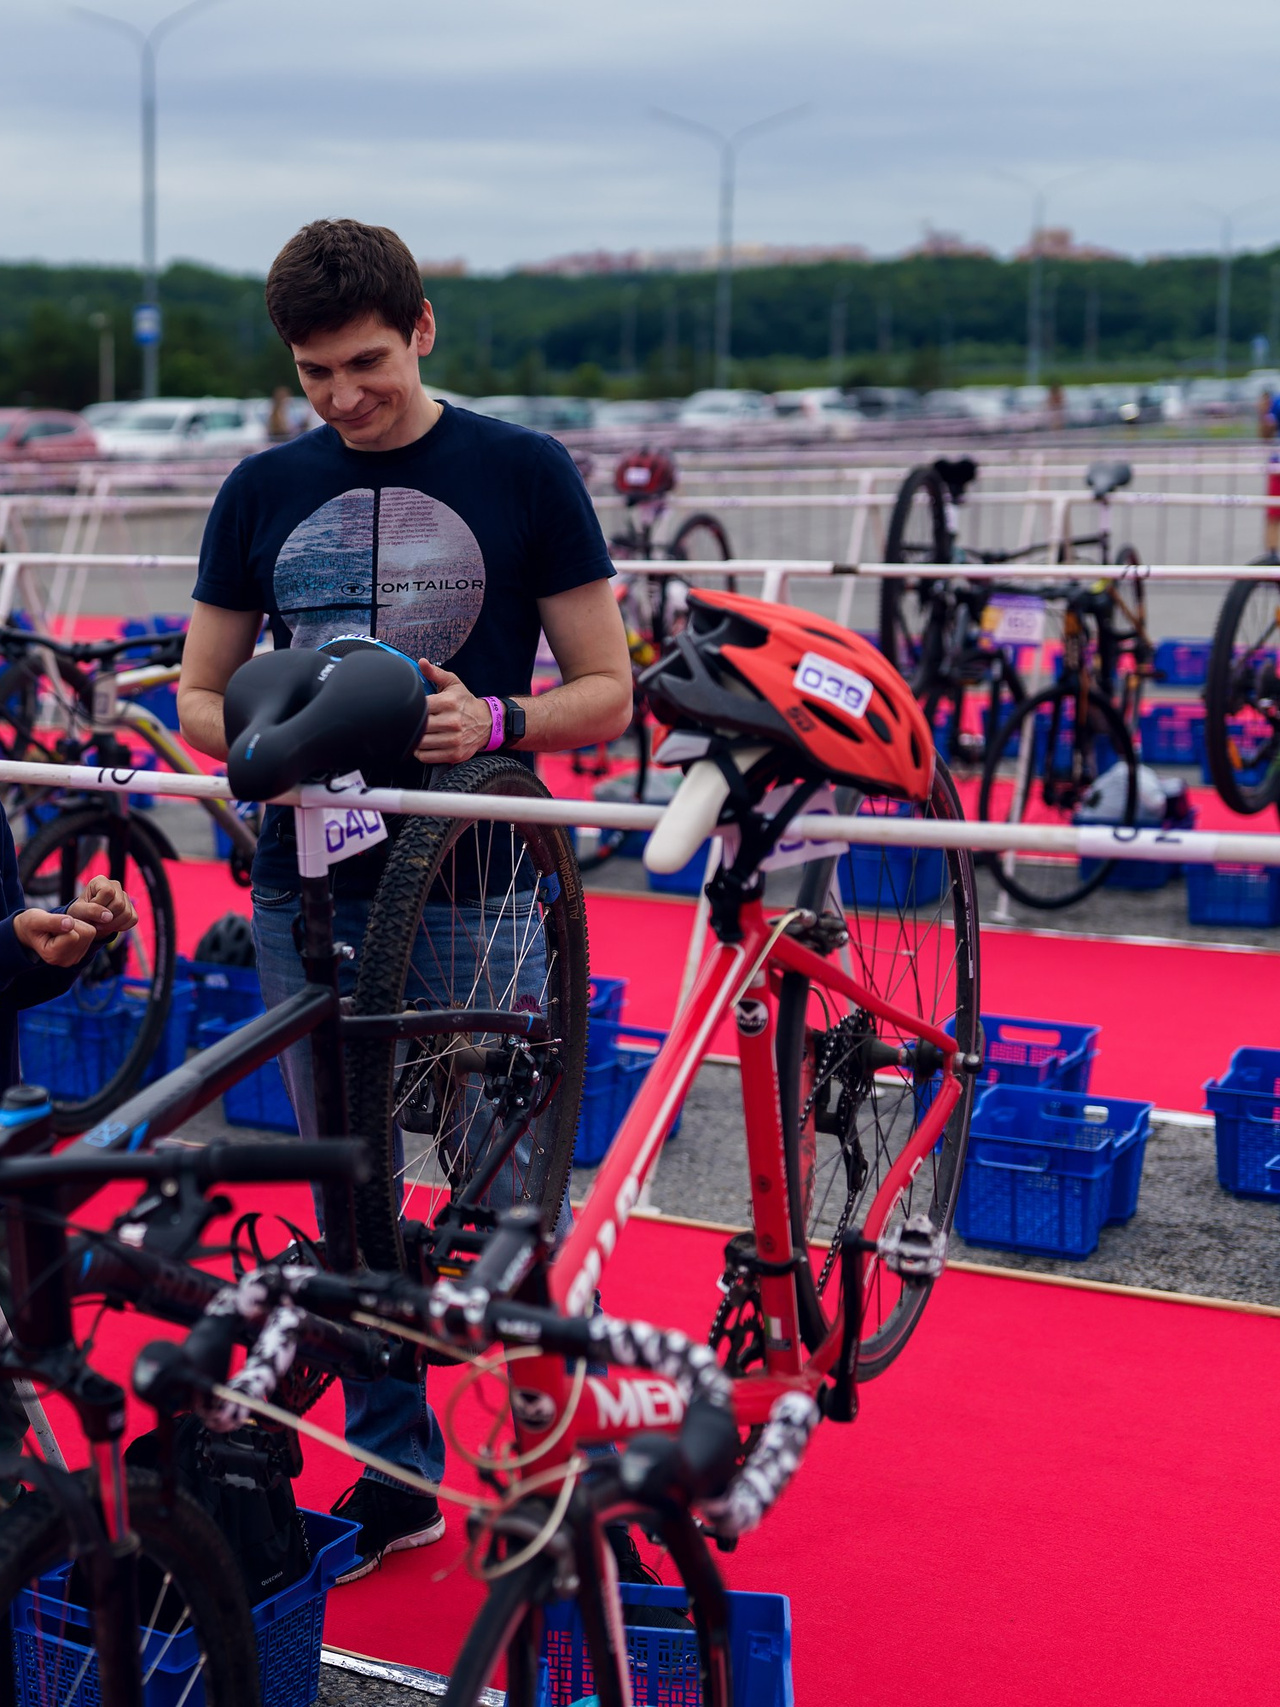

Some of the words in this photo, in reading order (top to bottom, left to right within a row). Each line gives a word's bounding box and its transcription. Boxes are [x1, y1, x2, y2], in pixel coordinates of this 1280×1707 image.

[412, 579, 484, 591] TAILOR
[802, 667, 864, 709] 039
[325, 809, 380, 853] 040
[558, 857, 578, 902] TERRAIN
[569, 900, 580, 920] ALL
[260, 1570, 284, 1587] QUECHUA
